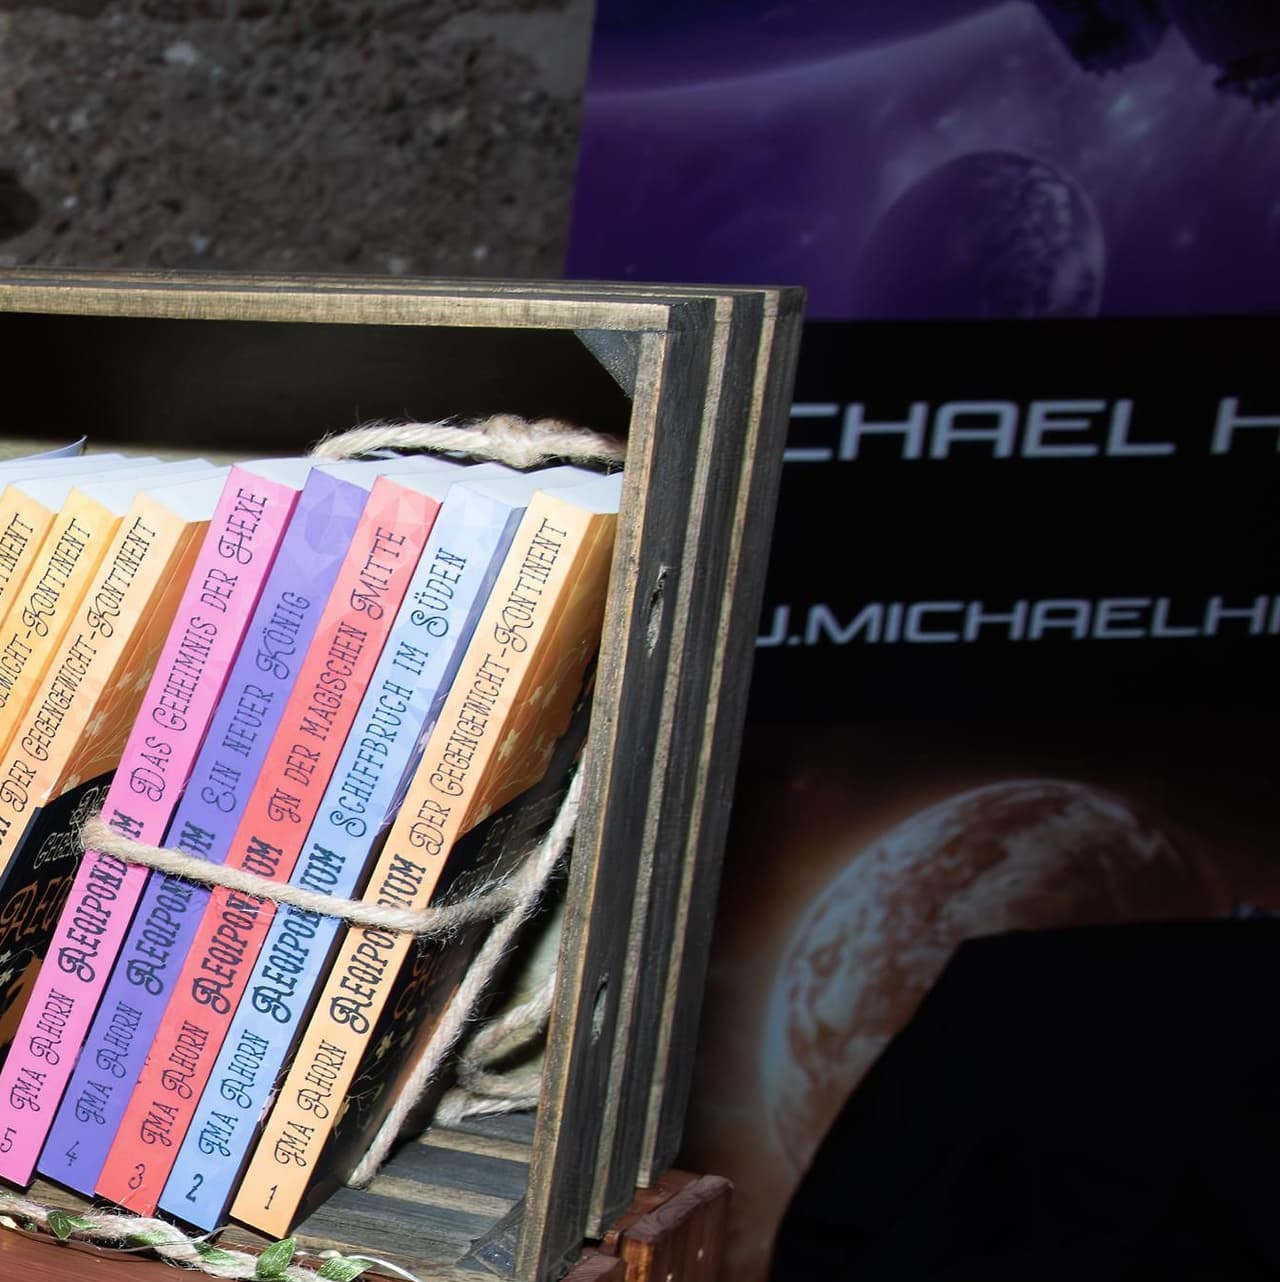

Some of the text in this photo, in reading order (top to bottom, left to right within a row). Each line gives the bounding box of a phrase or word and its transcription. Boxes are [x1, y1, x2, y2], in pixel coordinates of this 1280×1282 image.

[782, 399, 1175, 461] CHAEL
[0, 1126, 18, 1153] 5
[64, 1140, 79, 1167] 4
[127, 1162, 147, 1190] 3
[185, 1172, 205, 1203] 2
